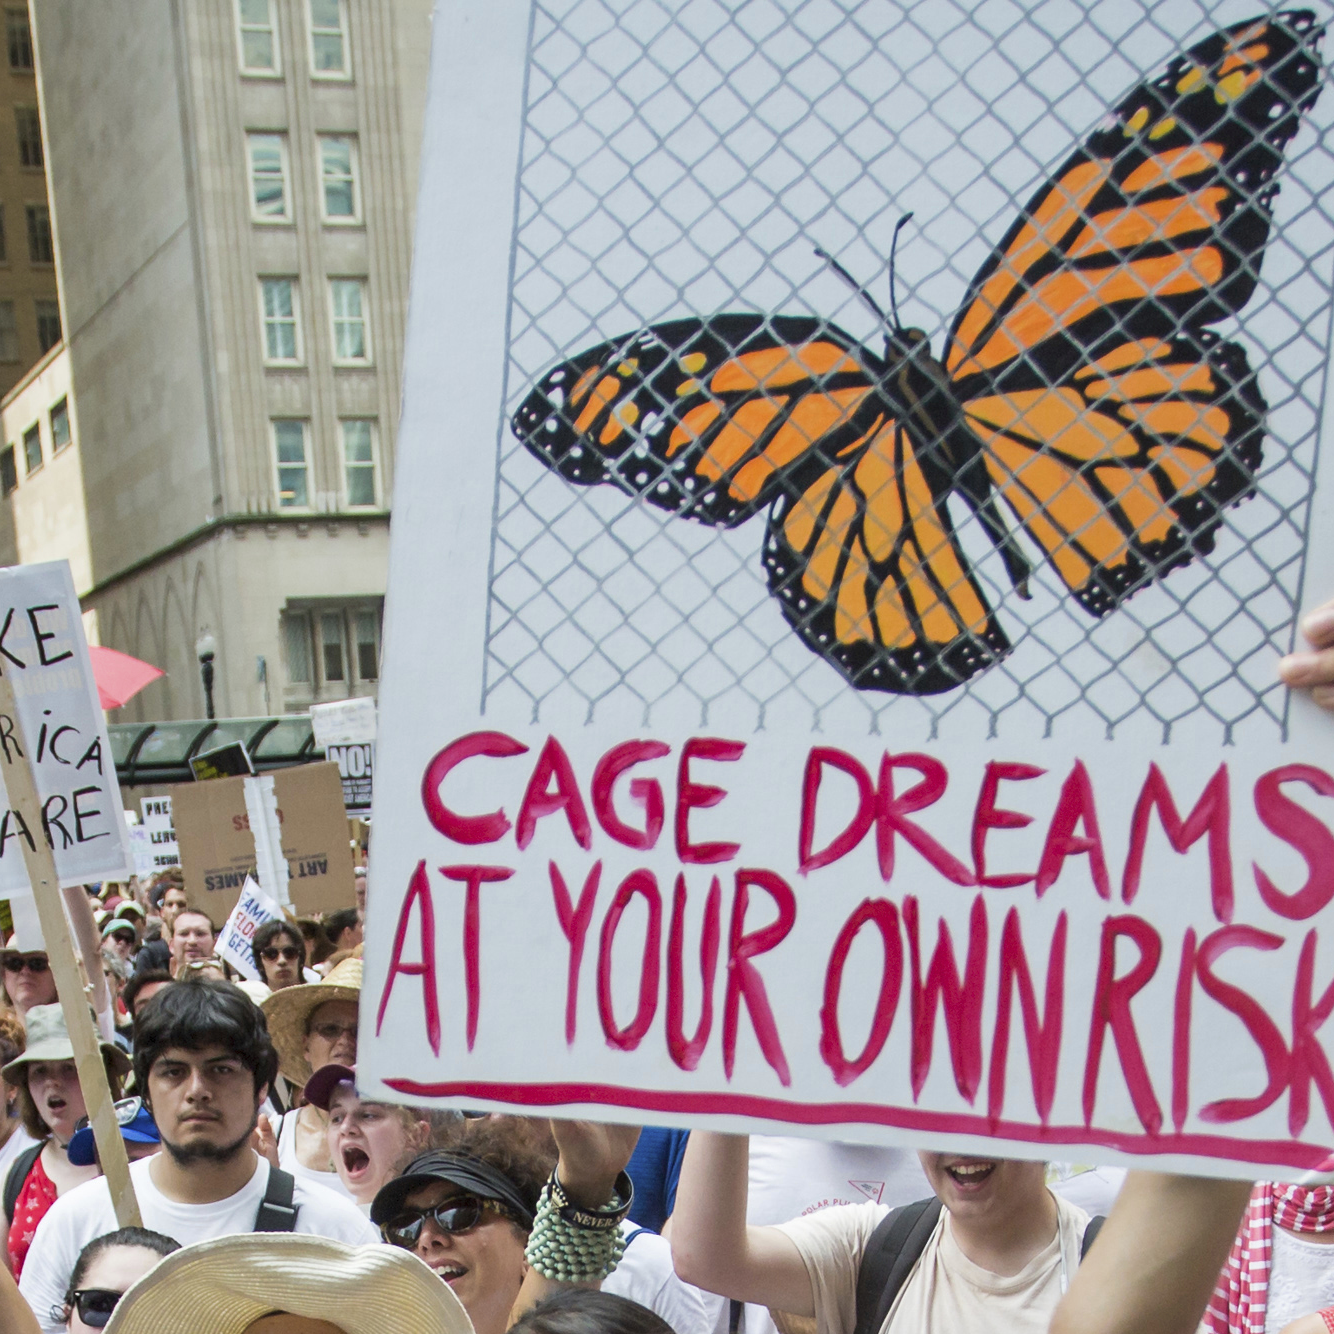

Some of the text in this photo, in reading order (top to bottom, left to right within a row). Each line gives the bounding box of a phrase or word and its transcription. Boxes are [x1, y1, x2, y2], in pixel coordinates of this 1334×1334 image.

[420, 730, 749, 864] CAGE
[376, 858, 515, 1057] AT
[548, 858, 793, 1088] YOUR
[819, 894, 1067, 1131] OWN
[573, 1211, 613, 1227] NEVER
